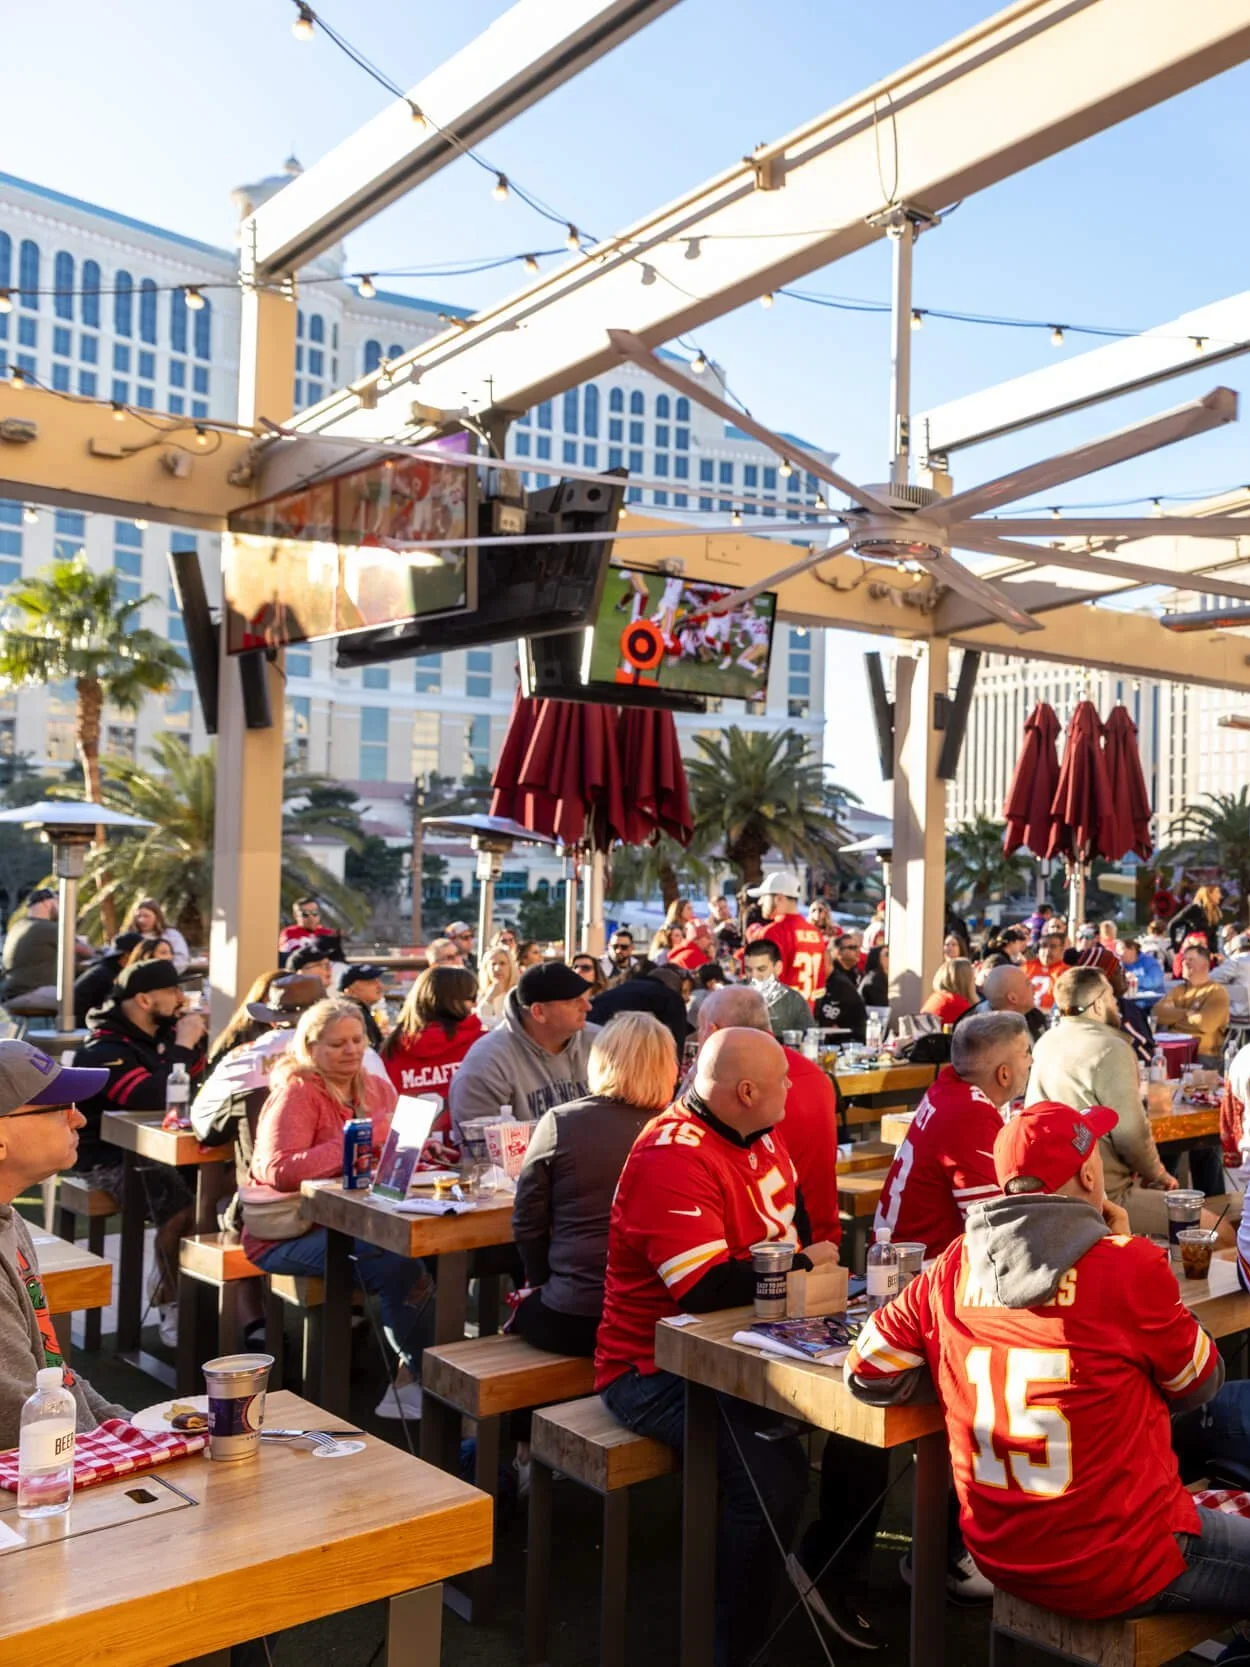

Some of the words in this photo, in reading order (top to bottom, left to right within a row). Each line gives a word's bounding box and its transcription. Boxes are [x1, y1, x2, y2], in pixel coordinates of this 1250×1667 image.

[792, 952, 822, 1000] 31
[655, 1122, 706, 1147] 15
[965, 1346, 1073, 1497] 15
